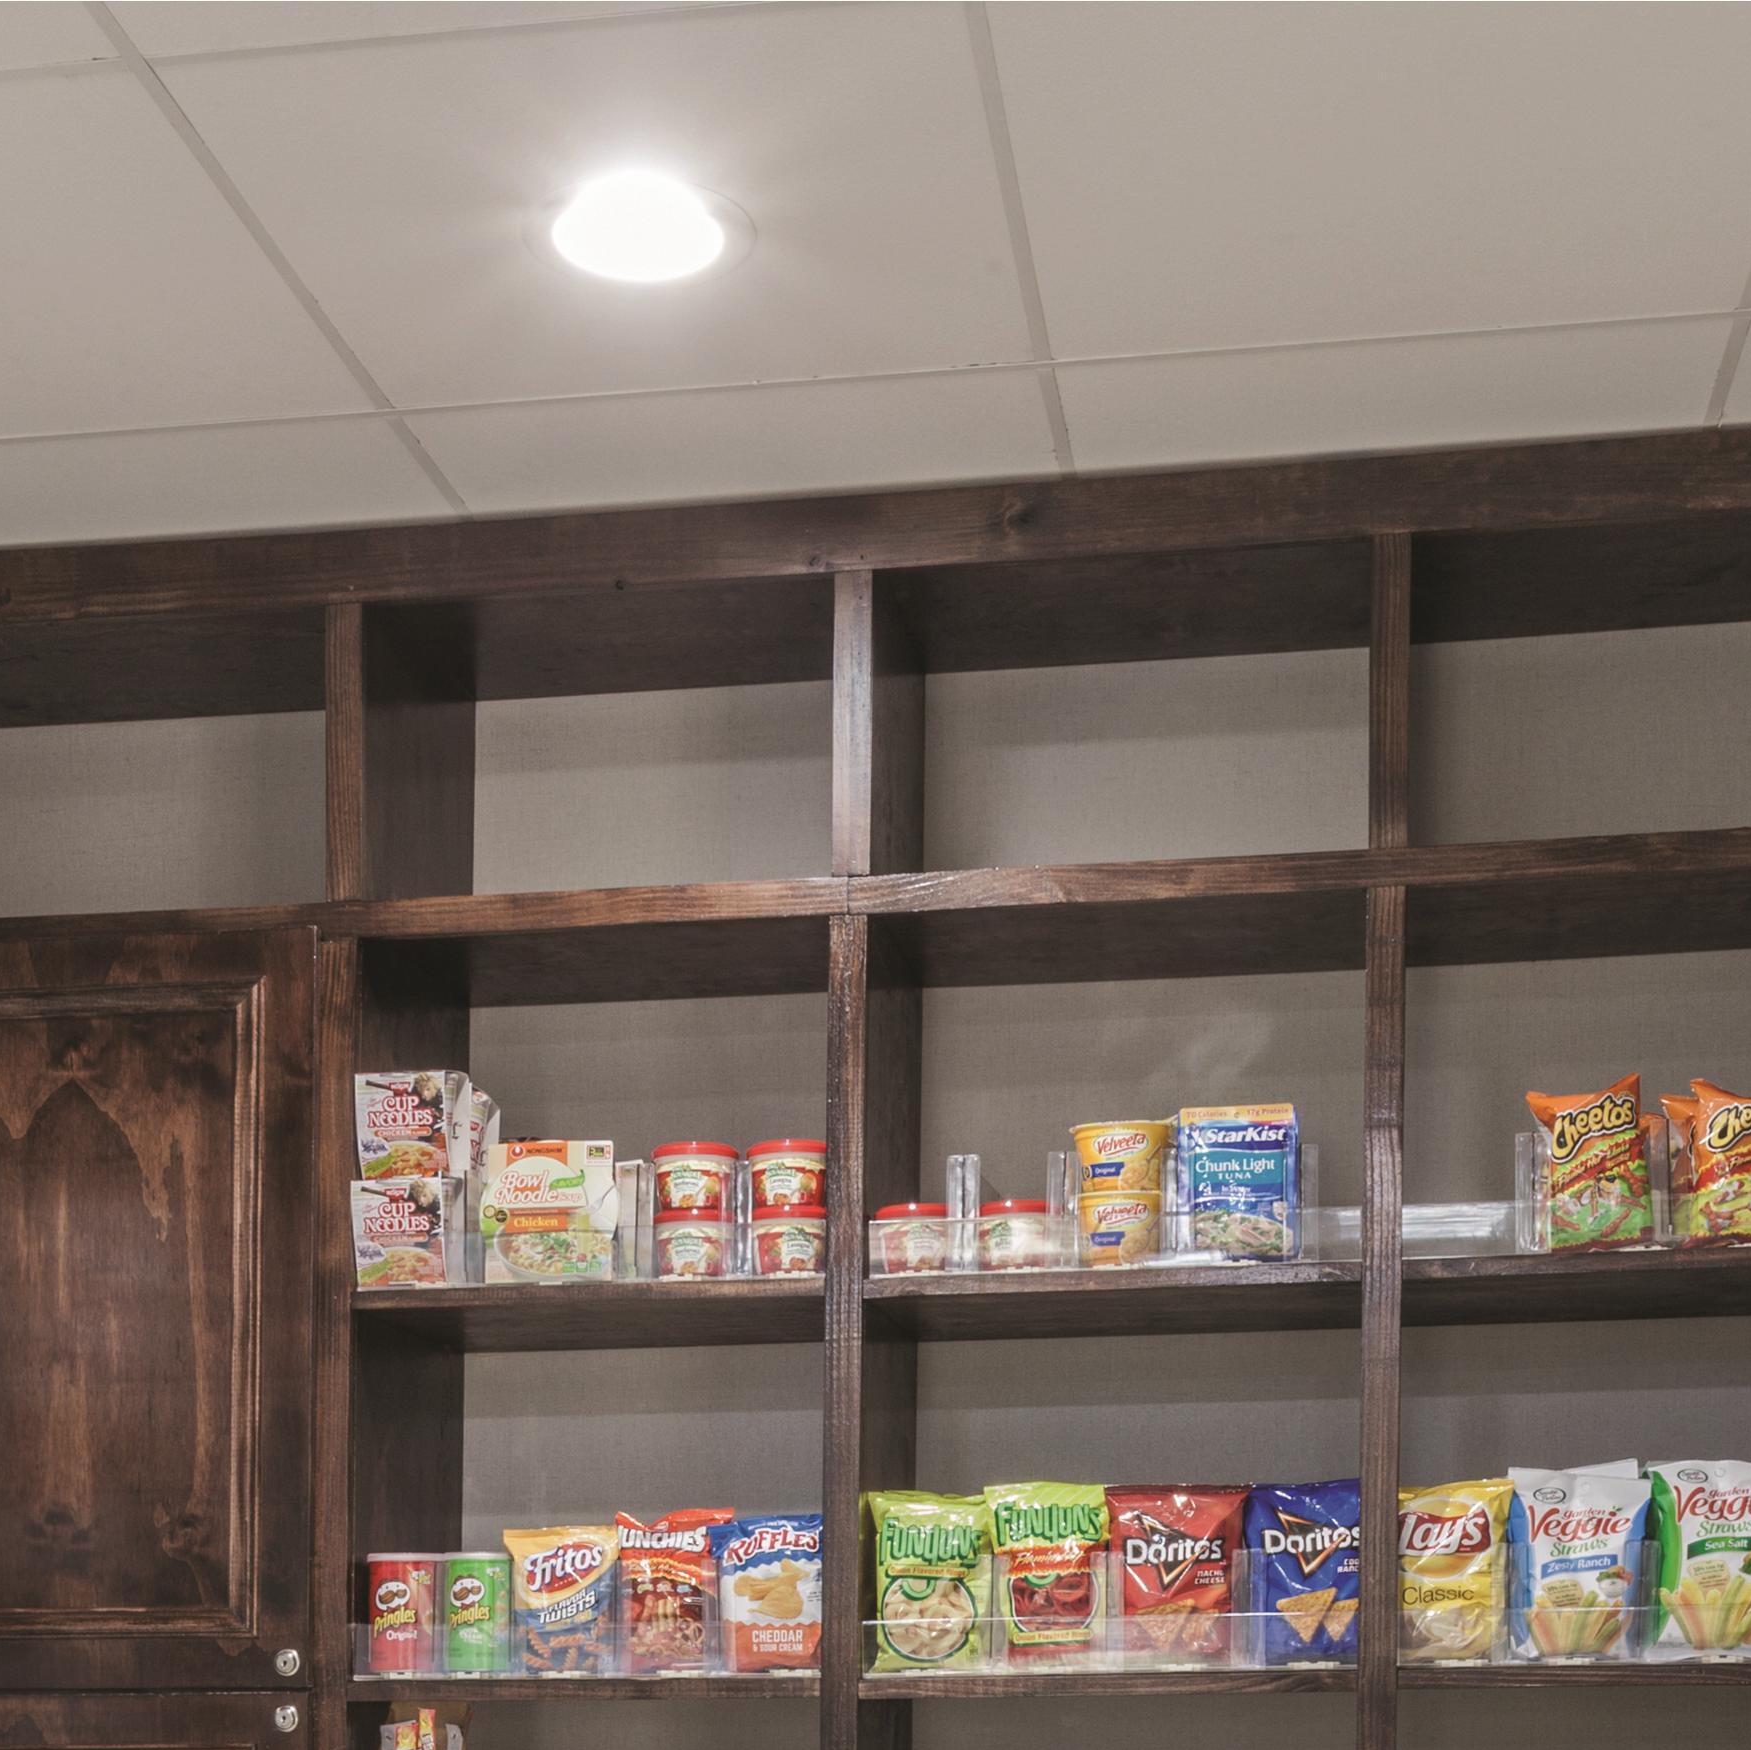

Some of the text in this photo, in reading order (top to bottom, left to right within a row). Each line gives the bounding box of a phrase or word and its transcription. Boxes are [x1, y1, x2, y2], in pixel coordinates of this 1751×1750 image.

[381, 1095, 420, 1113] CUP
[367, 1110, 434, 1129] NOODLES
[1551, 1095, 1636, 1162] Cheetos
[1096, 1132, 1147, 1153] Velveeta
[1204, 1125, 1287, 1144] StarKist
[1195, 1158, 1275, 1174] Chunk Light
[1217, 1172, 1252, 1180] TUNA
[502, 1169, 550, 1190] Bowl
[496, 1186, 559, 1205] Noodle
[378, 1201, 416, 1218] CUP
[1096, 1202, 1148, 1224] Velveeta
[364, 1216, 430, 1235] NOODLES
[513, 1216, 560, 1228] Chicken
[1706, 1487, 1750, 1499] garden
[997, 1503, 1103, 1545] FUNYUNS
[1527, 1504, 1632, 1544] Veggie
[1561, 1507, 1607, 1520] garden
[724, 1529, 820, 1565] RUFFLES
[880, 1516, 983, 1568] FUNYUNS
[1125, 1536, 1223, 1565] Doritos
[1263, 1526, 1360, 1556] Doritos
[1550, 1536, 1612, 1557] Straws
[1704, 1537, 1749, 1551] Sea Salt
[523, 1543, 603, 1592] Fritos
[1547, 1556, 1612, 1574] Zesty Ranch
[1193, 1575, 1226, 1585] CHEESE
[1401, 1585, 1475, 1606] Classic
[451, 1603, 491, 1632] Pringles
[537, 1591, 596, 1625] TWISTS
[373, 1606, 417, 1639] Pringles
[751, 1630, 803, 1643] CHEDDAR
